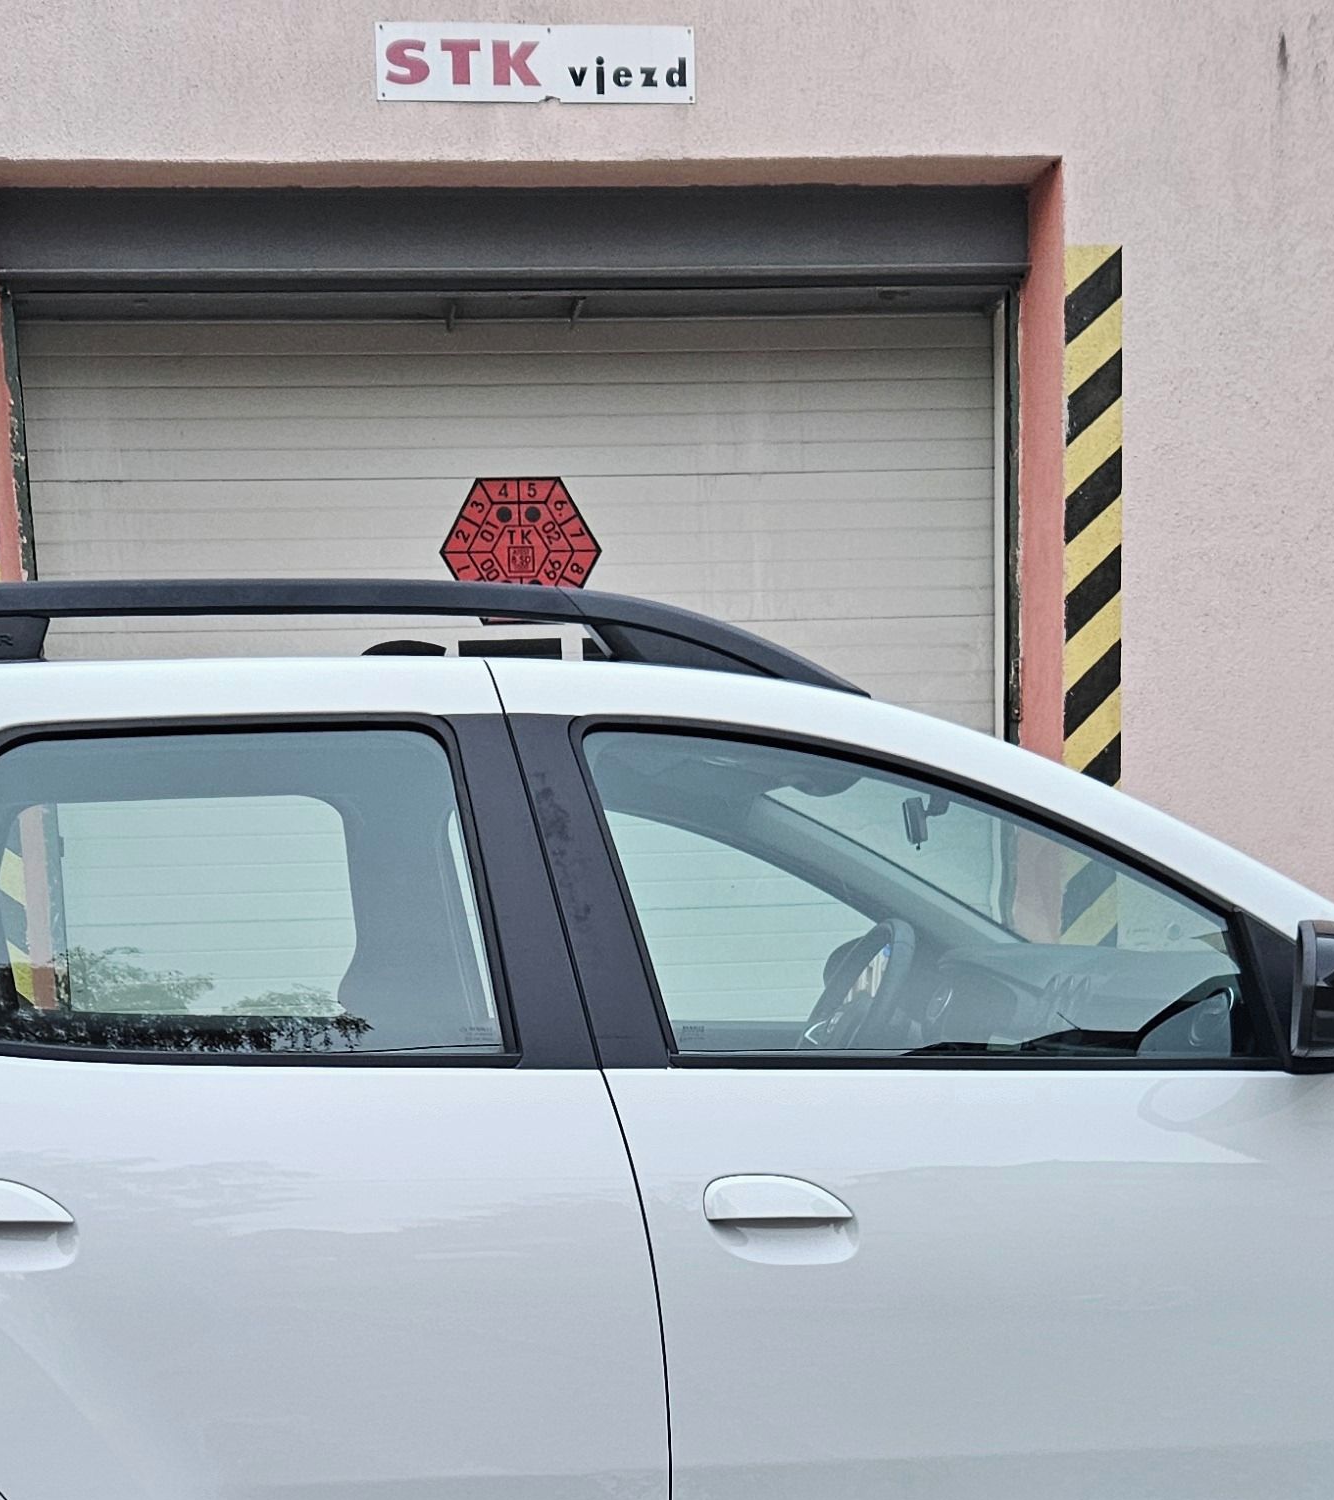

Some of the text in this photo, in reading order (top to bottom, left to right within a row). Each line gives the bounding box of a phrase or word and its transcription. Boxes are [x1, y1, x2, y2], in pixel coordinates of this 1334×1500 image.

[385, 38, 687, 95] STK vjezd
[498, 483, 509, 498] 4
[527, 483, 537, 497] 5
[470, 500, 485, 513] 3
[455, 529, 471, 543] 2
[507, 530, 532, 545] TK
[570, 527, 586, 539] 7
[570, 563, 585, 576] 8
